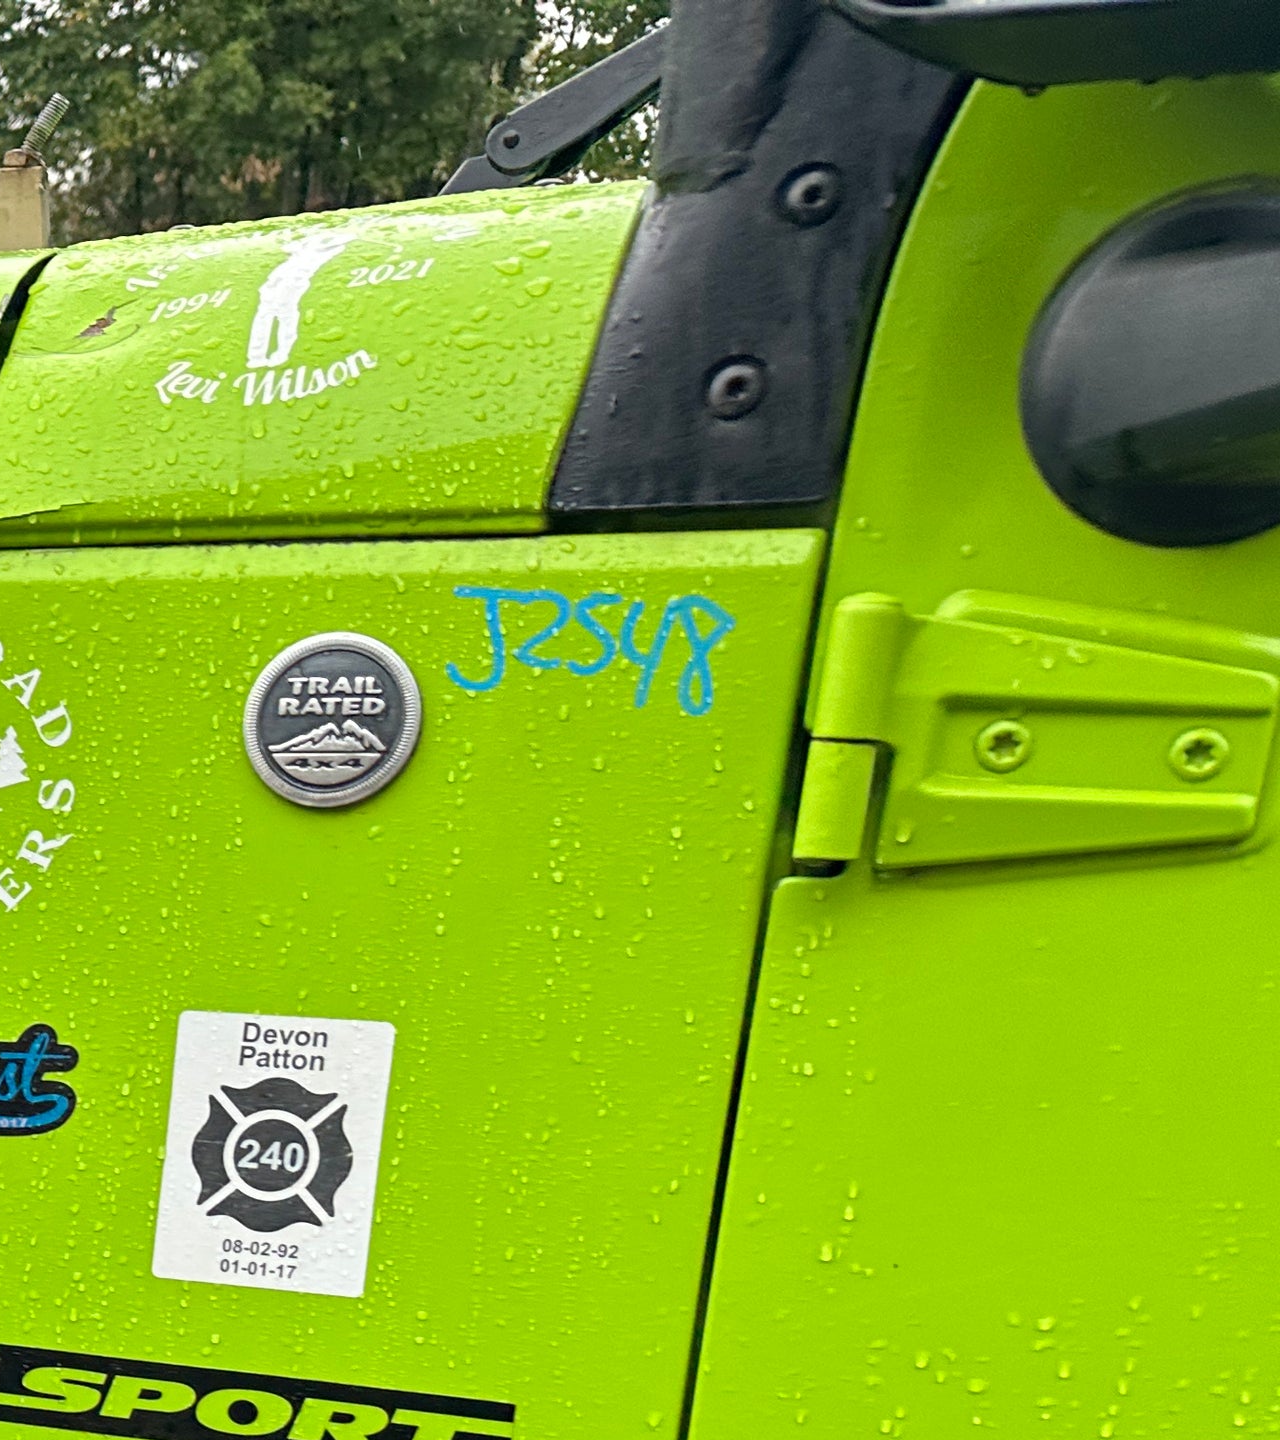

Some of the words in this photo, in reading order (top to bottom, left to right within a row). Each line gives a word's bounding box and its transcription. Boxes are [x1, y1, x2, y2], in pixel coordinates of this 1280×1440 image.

[347, 257, 435, 288] 2021
[149, 289, 232, 323] 1994
[232, 349, 378, 406] Wilson
[287, 676, 383, 695] TRAIL
[277, 697, 386, 716] RATED
[242, 1022, 328, 1047] Devon
[238, 1046, 325, 1071] Patton
[237, 1139, 305, 1172] 240
[222, 1239, 299, 1259] 08-02-92
[219, 1259, 297, 1278] 01-01-17
